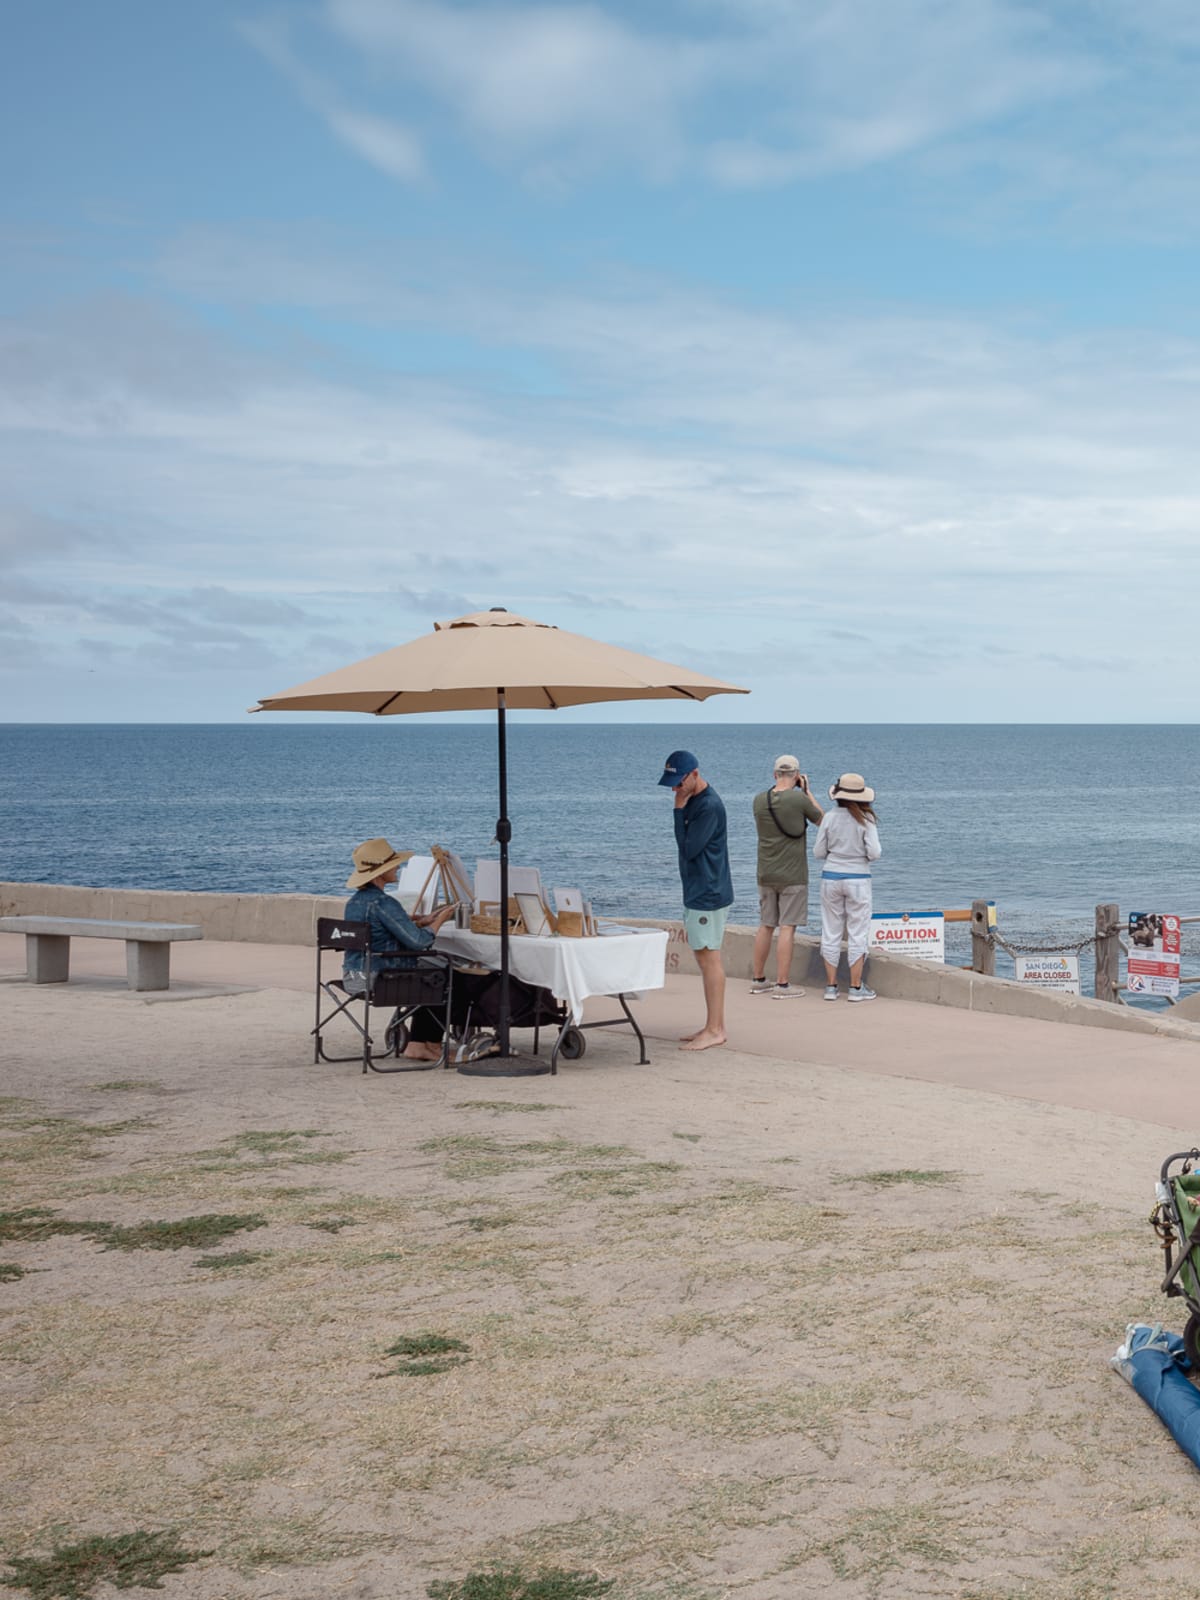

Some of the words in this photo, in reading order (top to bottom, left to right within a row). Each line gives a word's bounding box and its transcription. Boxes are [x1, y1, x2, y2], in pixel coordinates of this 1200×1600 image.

[875, 928, 937, 941] CAUTION
[1041, 962, 1065, 970] DIEGO
[1023, 971, 1042, 979] AREA
[1043, 971, 1072, 979] CLOSED
